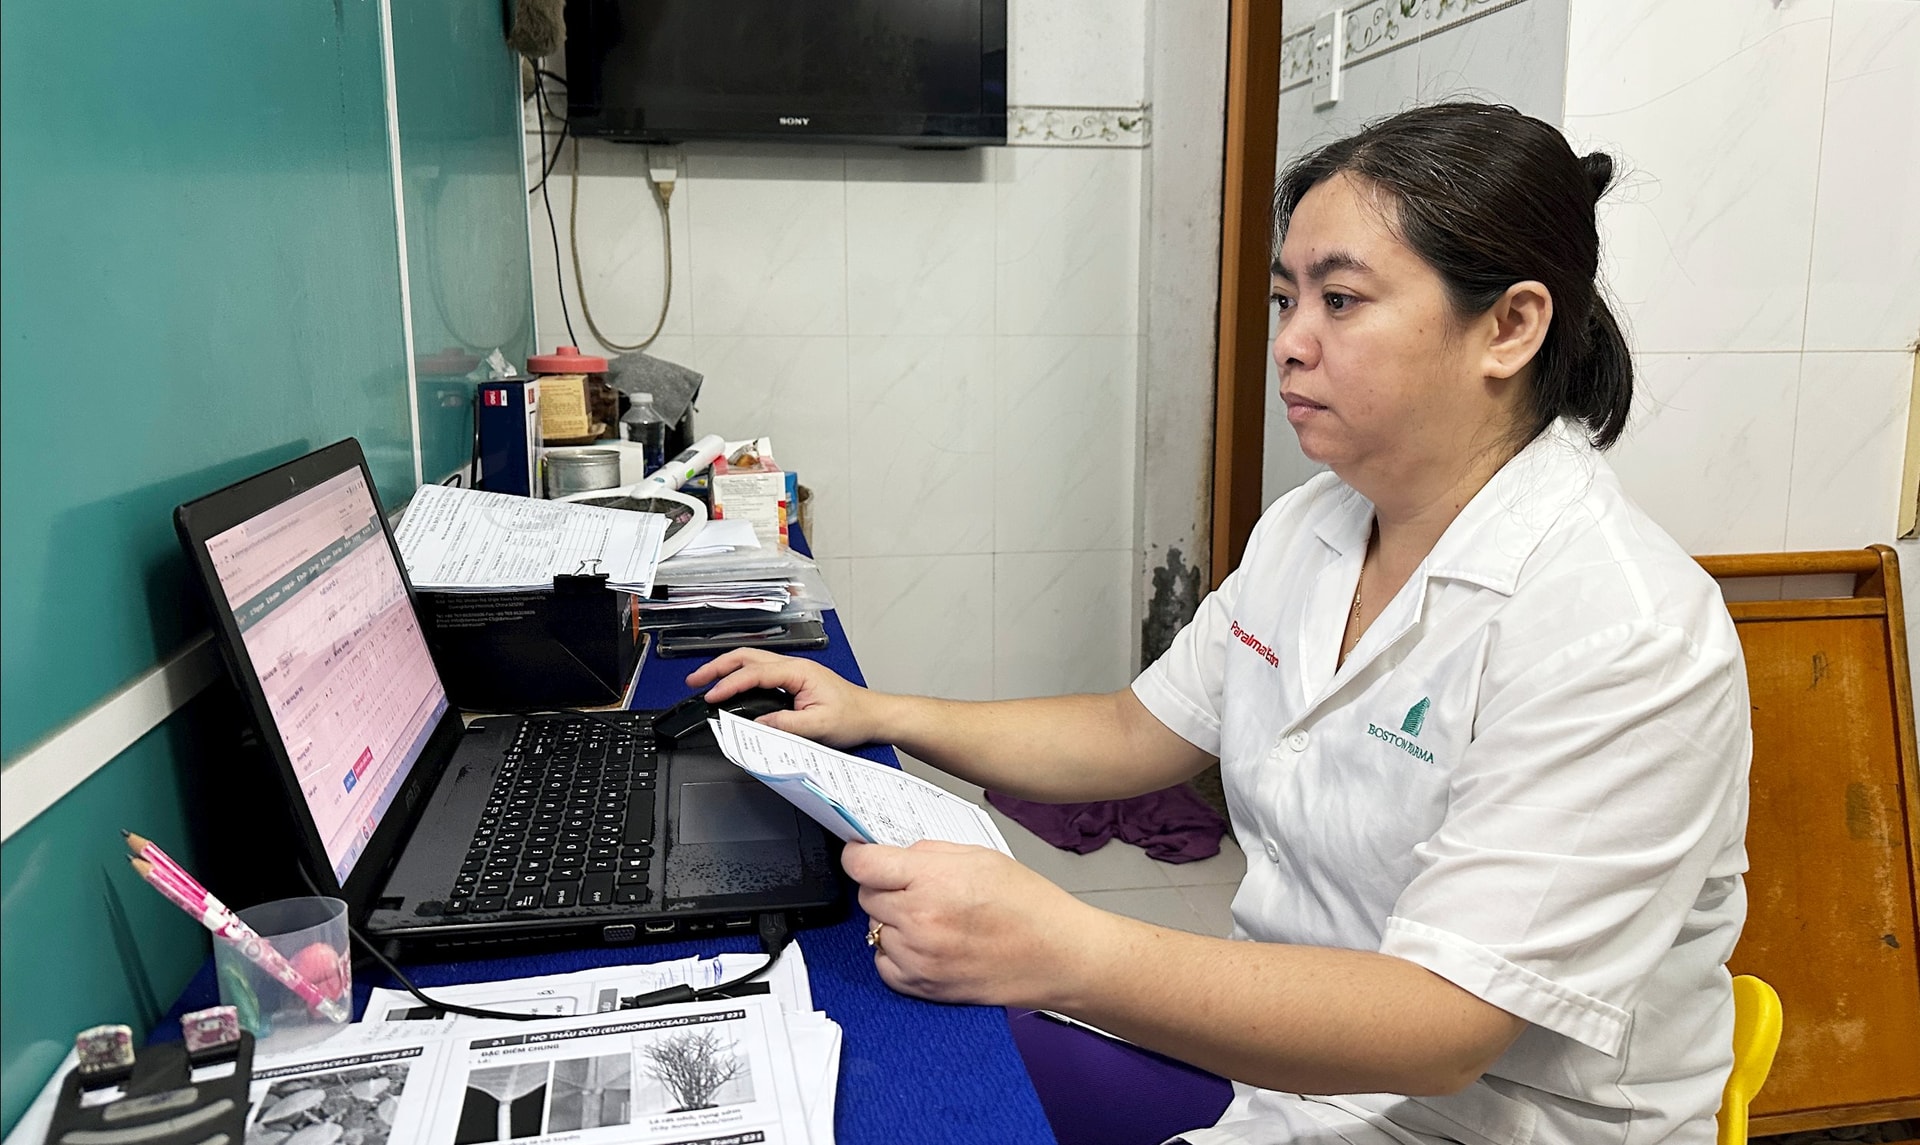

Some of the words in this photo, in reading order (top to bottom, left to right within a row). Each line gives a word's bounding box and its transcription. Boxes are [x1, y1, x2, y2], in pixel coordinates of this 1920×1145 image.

[779, 117, 810, 126] SONY
[1368, 722, 1408, 751] BOSTON
[601, 1017, 689, 1034] (EUPHORBIACEAE)
[699, 1014, 724, 1023] Trang
